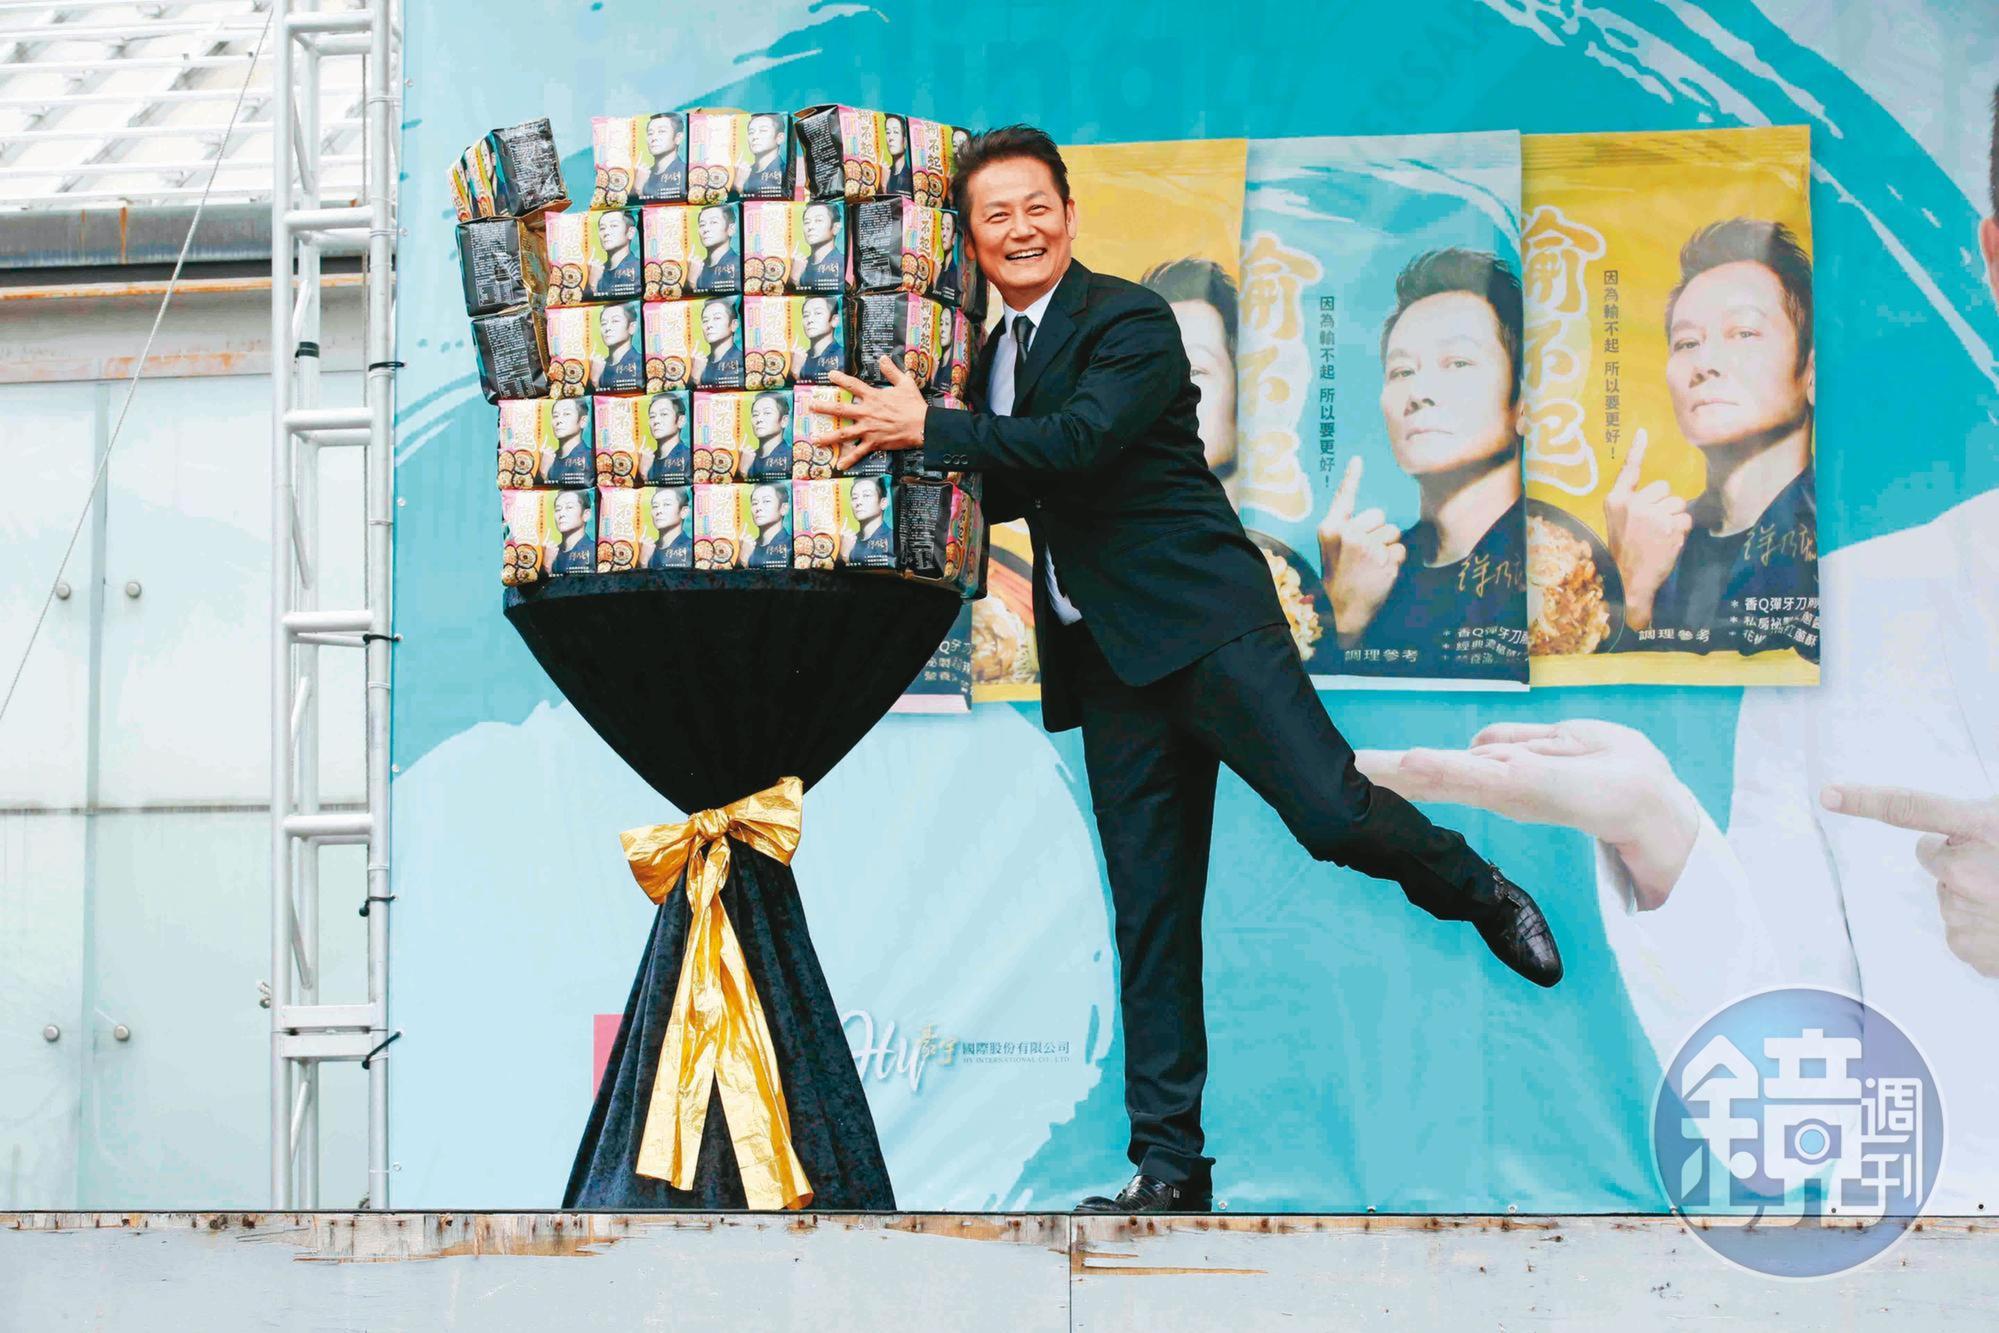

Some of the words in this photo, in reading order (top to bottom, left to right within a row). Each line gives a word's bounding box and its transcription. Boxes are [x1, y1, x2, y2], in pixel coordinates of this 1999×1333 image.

[1319, 295, 1336, 379] 因為輸不起
[1603, 269, 1620, 353] 因為輸不起
[962, 1041, 1071, 1055] 國際股份有限公司
